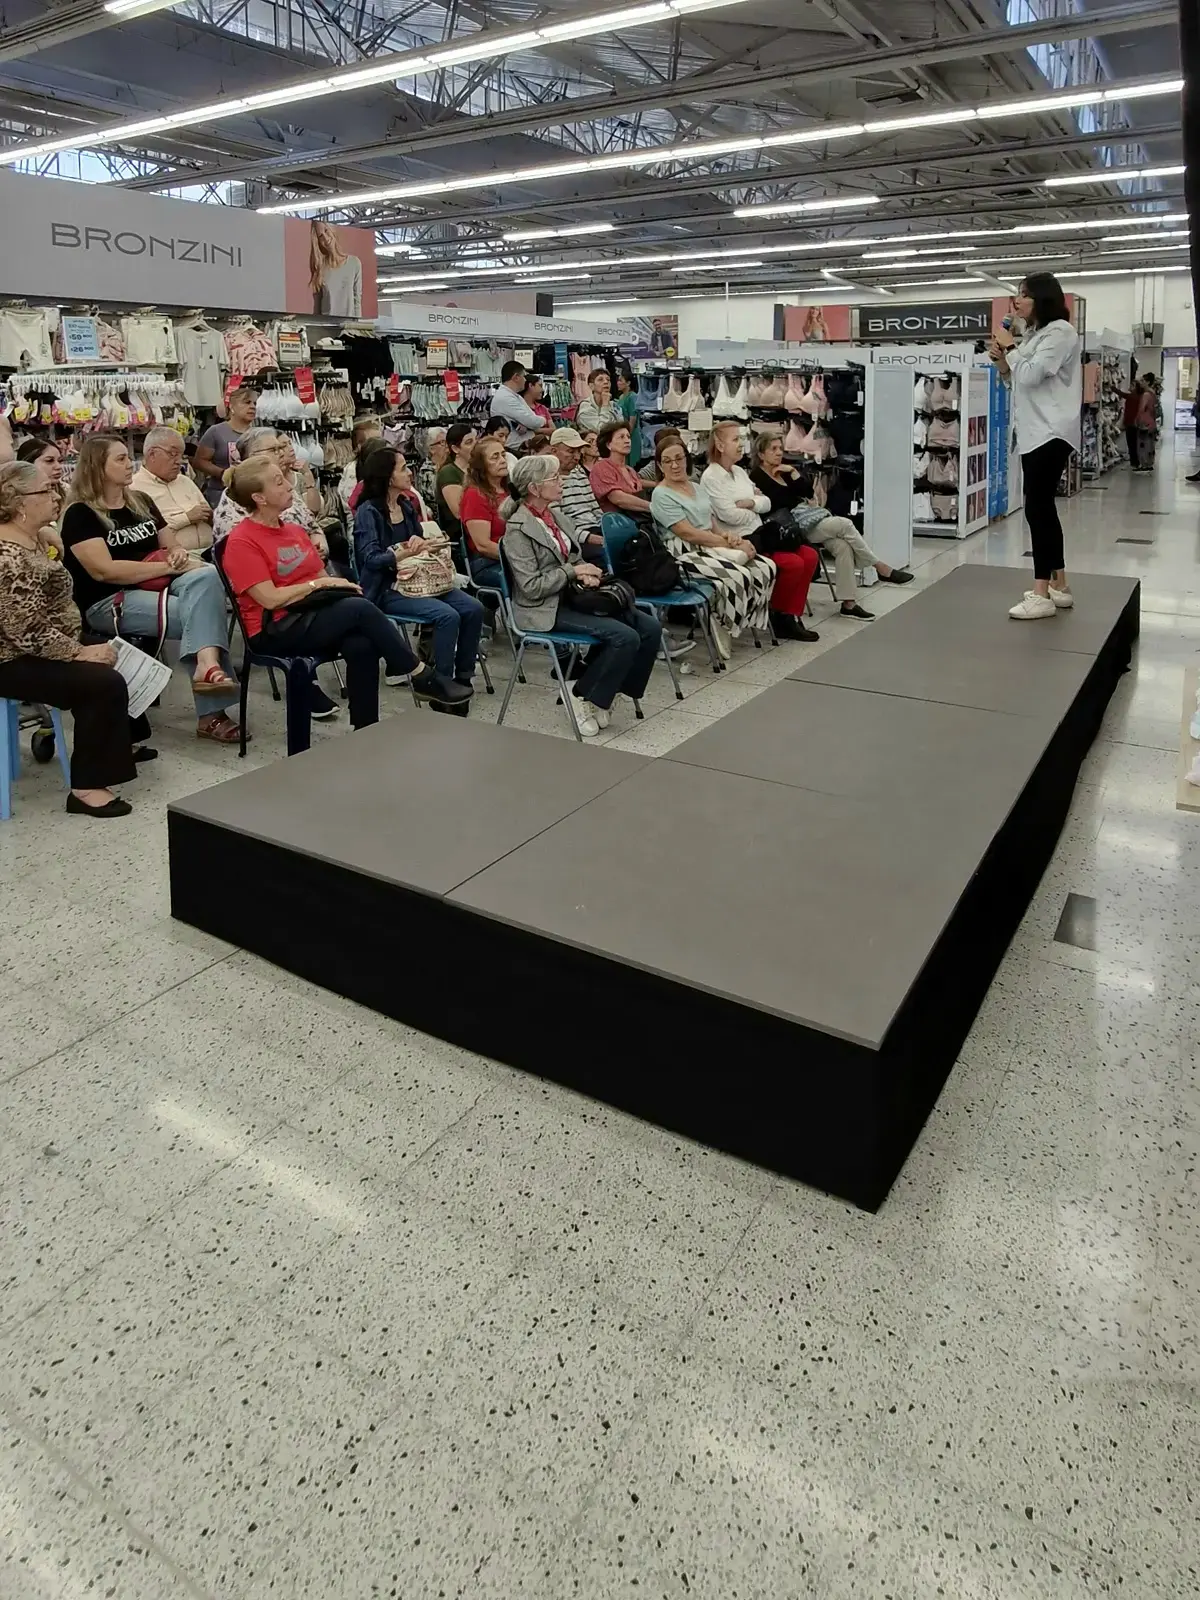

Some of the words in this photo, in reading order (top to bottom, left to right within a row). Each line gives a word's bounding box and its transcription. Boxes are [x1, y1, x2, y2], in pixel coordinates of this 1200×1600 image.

[51, 222, 242, 267] BRONZINI
[428, 313, 479, 326] BRONZINI
[868, 314, 987, 332] BRONZINI
[534, 322, 574, 333] BRONZINI
[878, 353, 966, 365] BRONZINI
